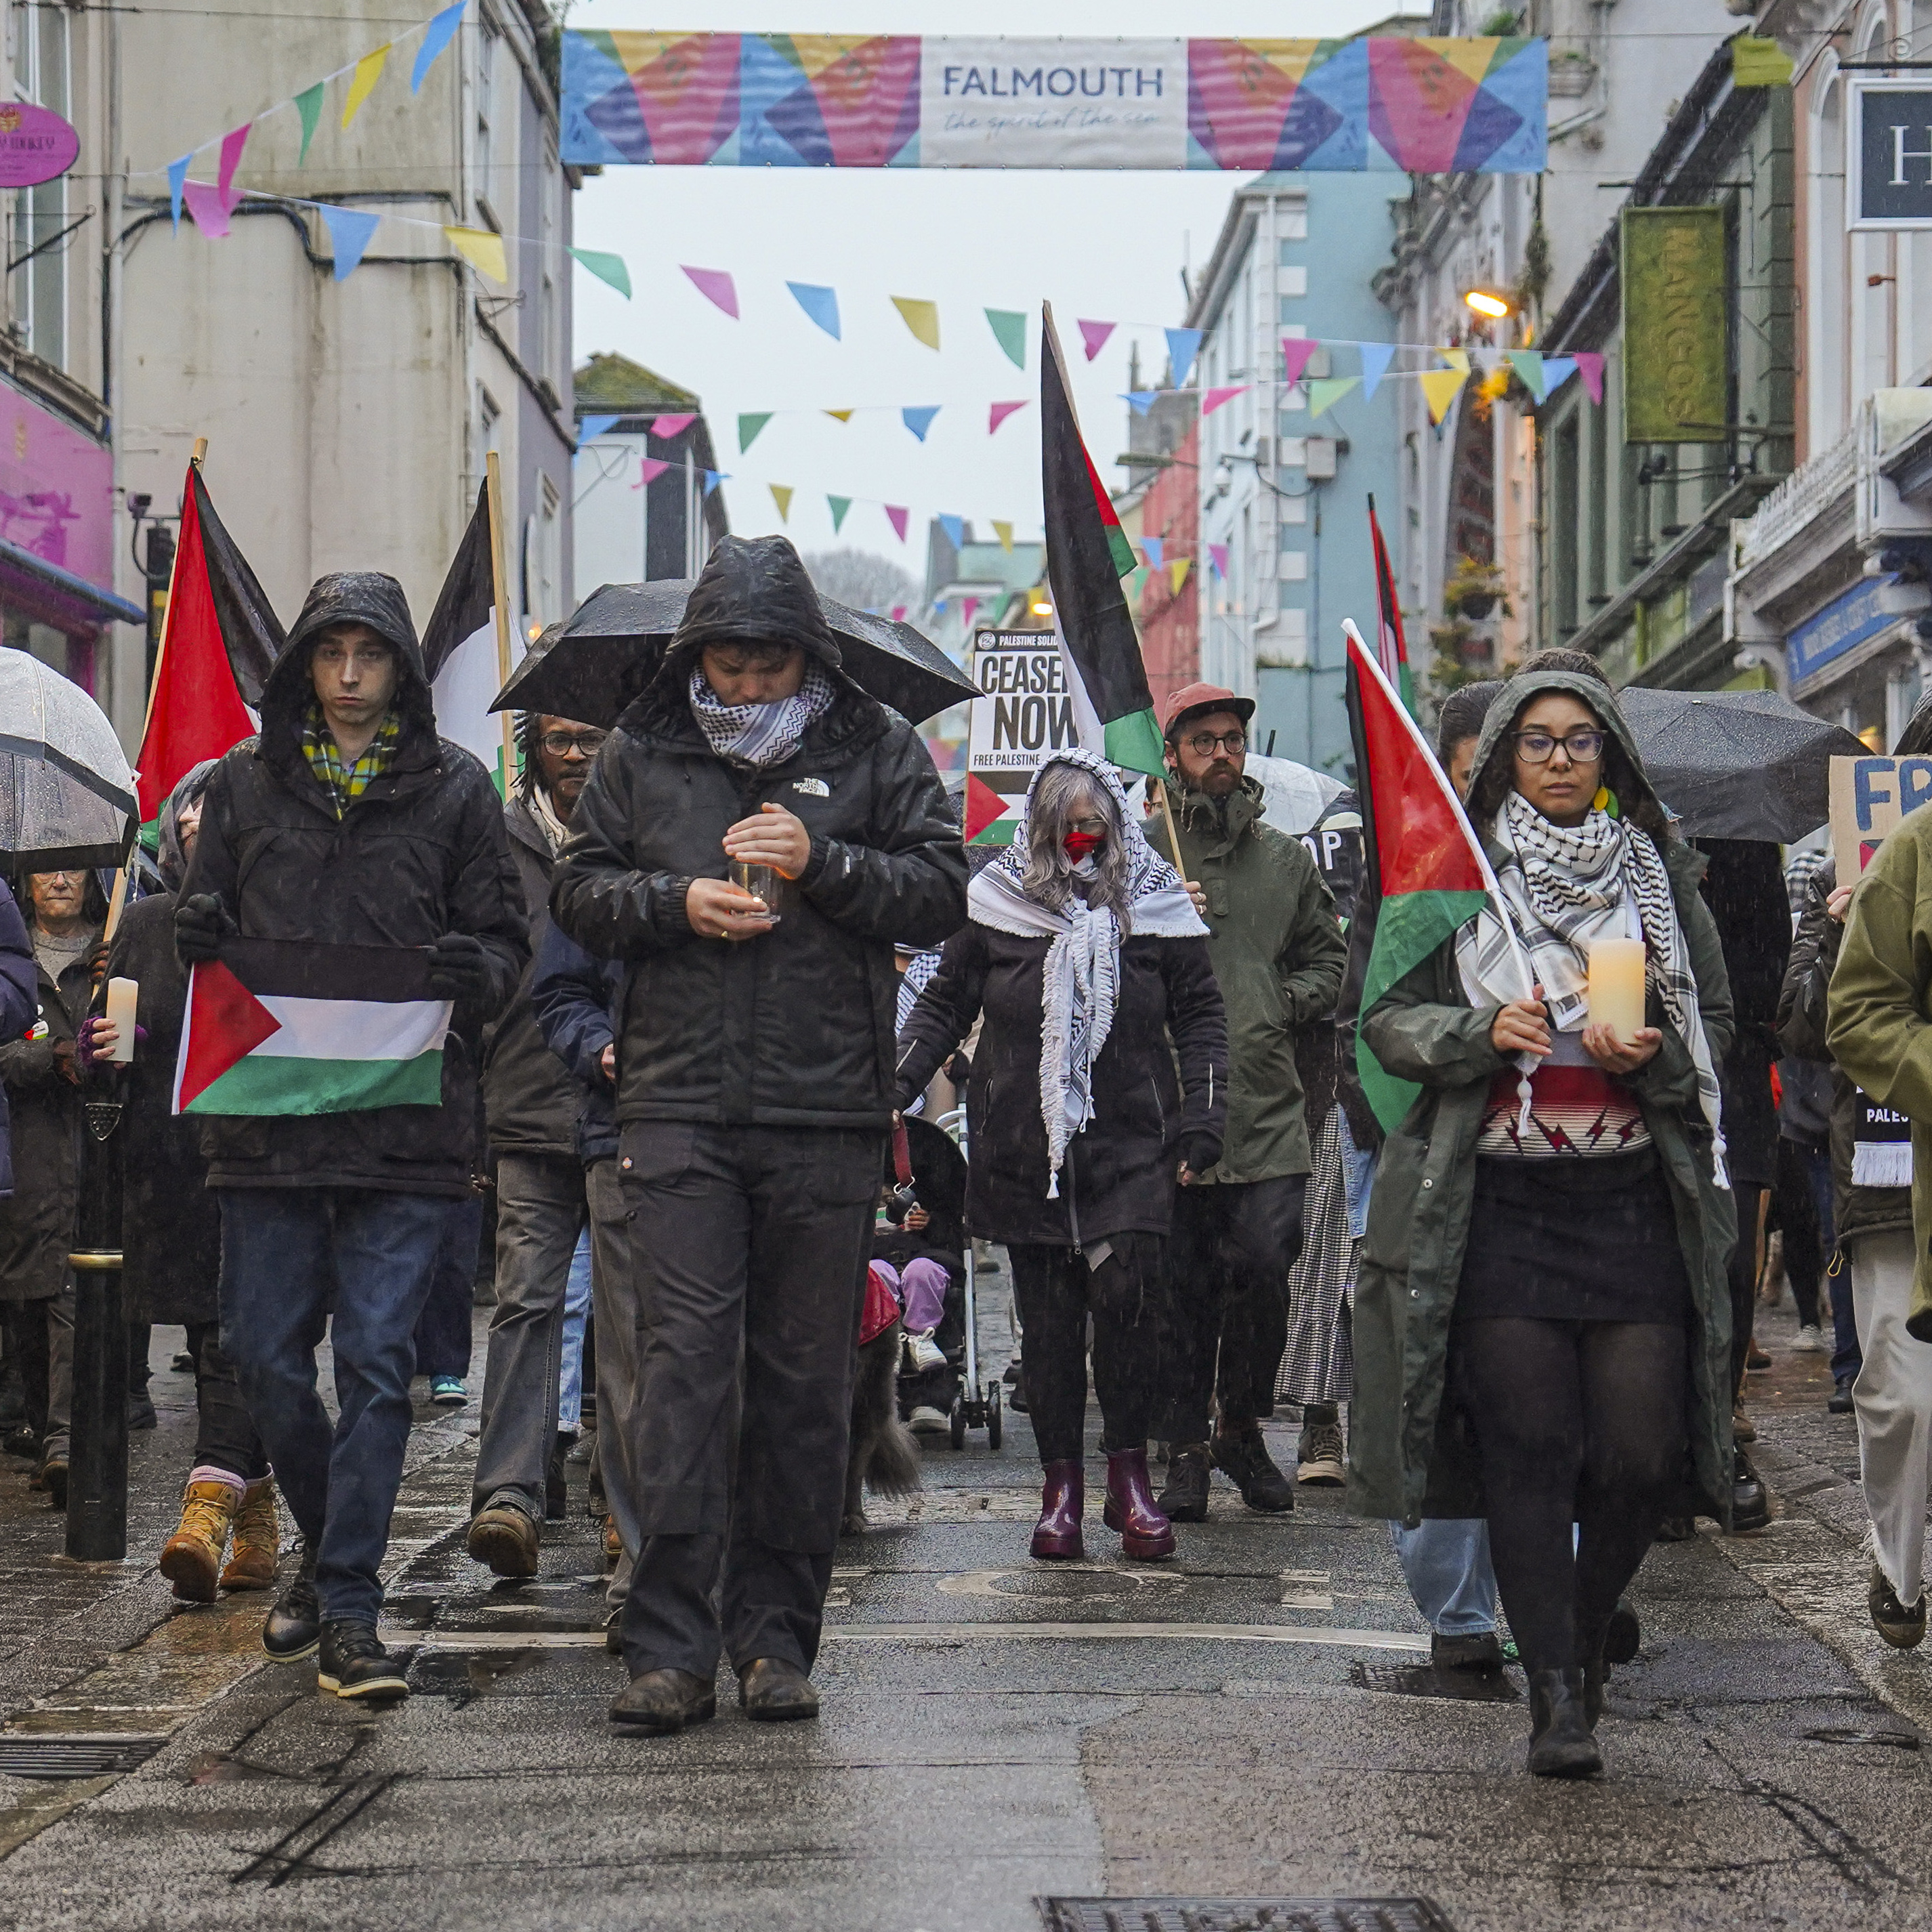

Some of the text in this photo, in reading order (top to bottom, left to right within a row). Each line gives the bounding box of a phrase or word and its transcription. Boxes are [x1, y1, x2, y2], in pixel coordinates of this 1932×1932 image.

[943, 65, 1163, 96] FALMOUTH
[999, 635, 1036, 646] PALESTINE
[993, 696, 1079, 750] NOW
[973, 754, 994, 765] FREE
[793, 782, 817, 791] NORTH
